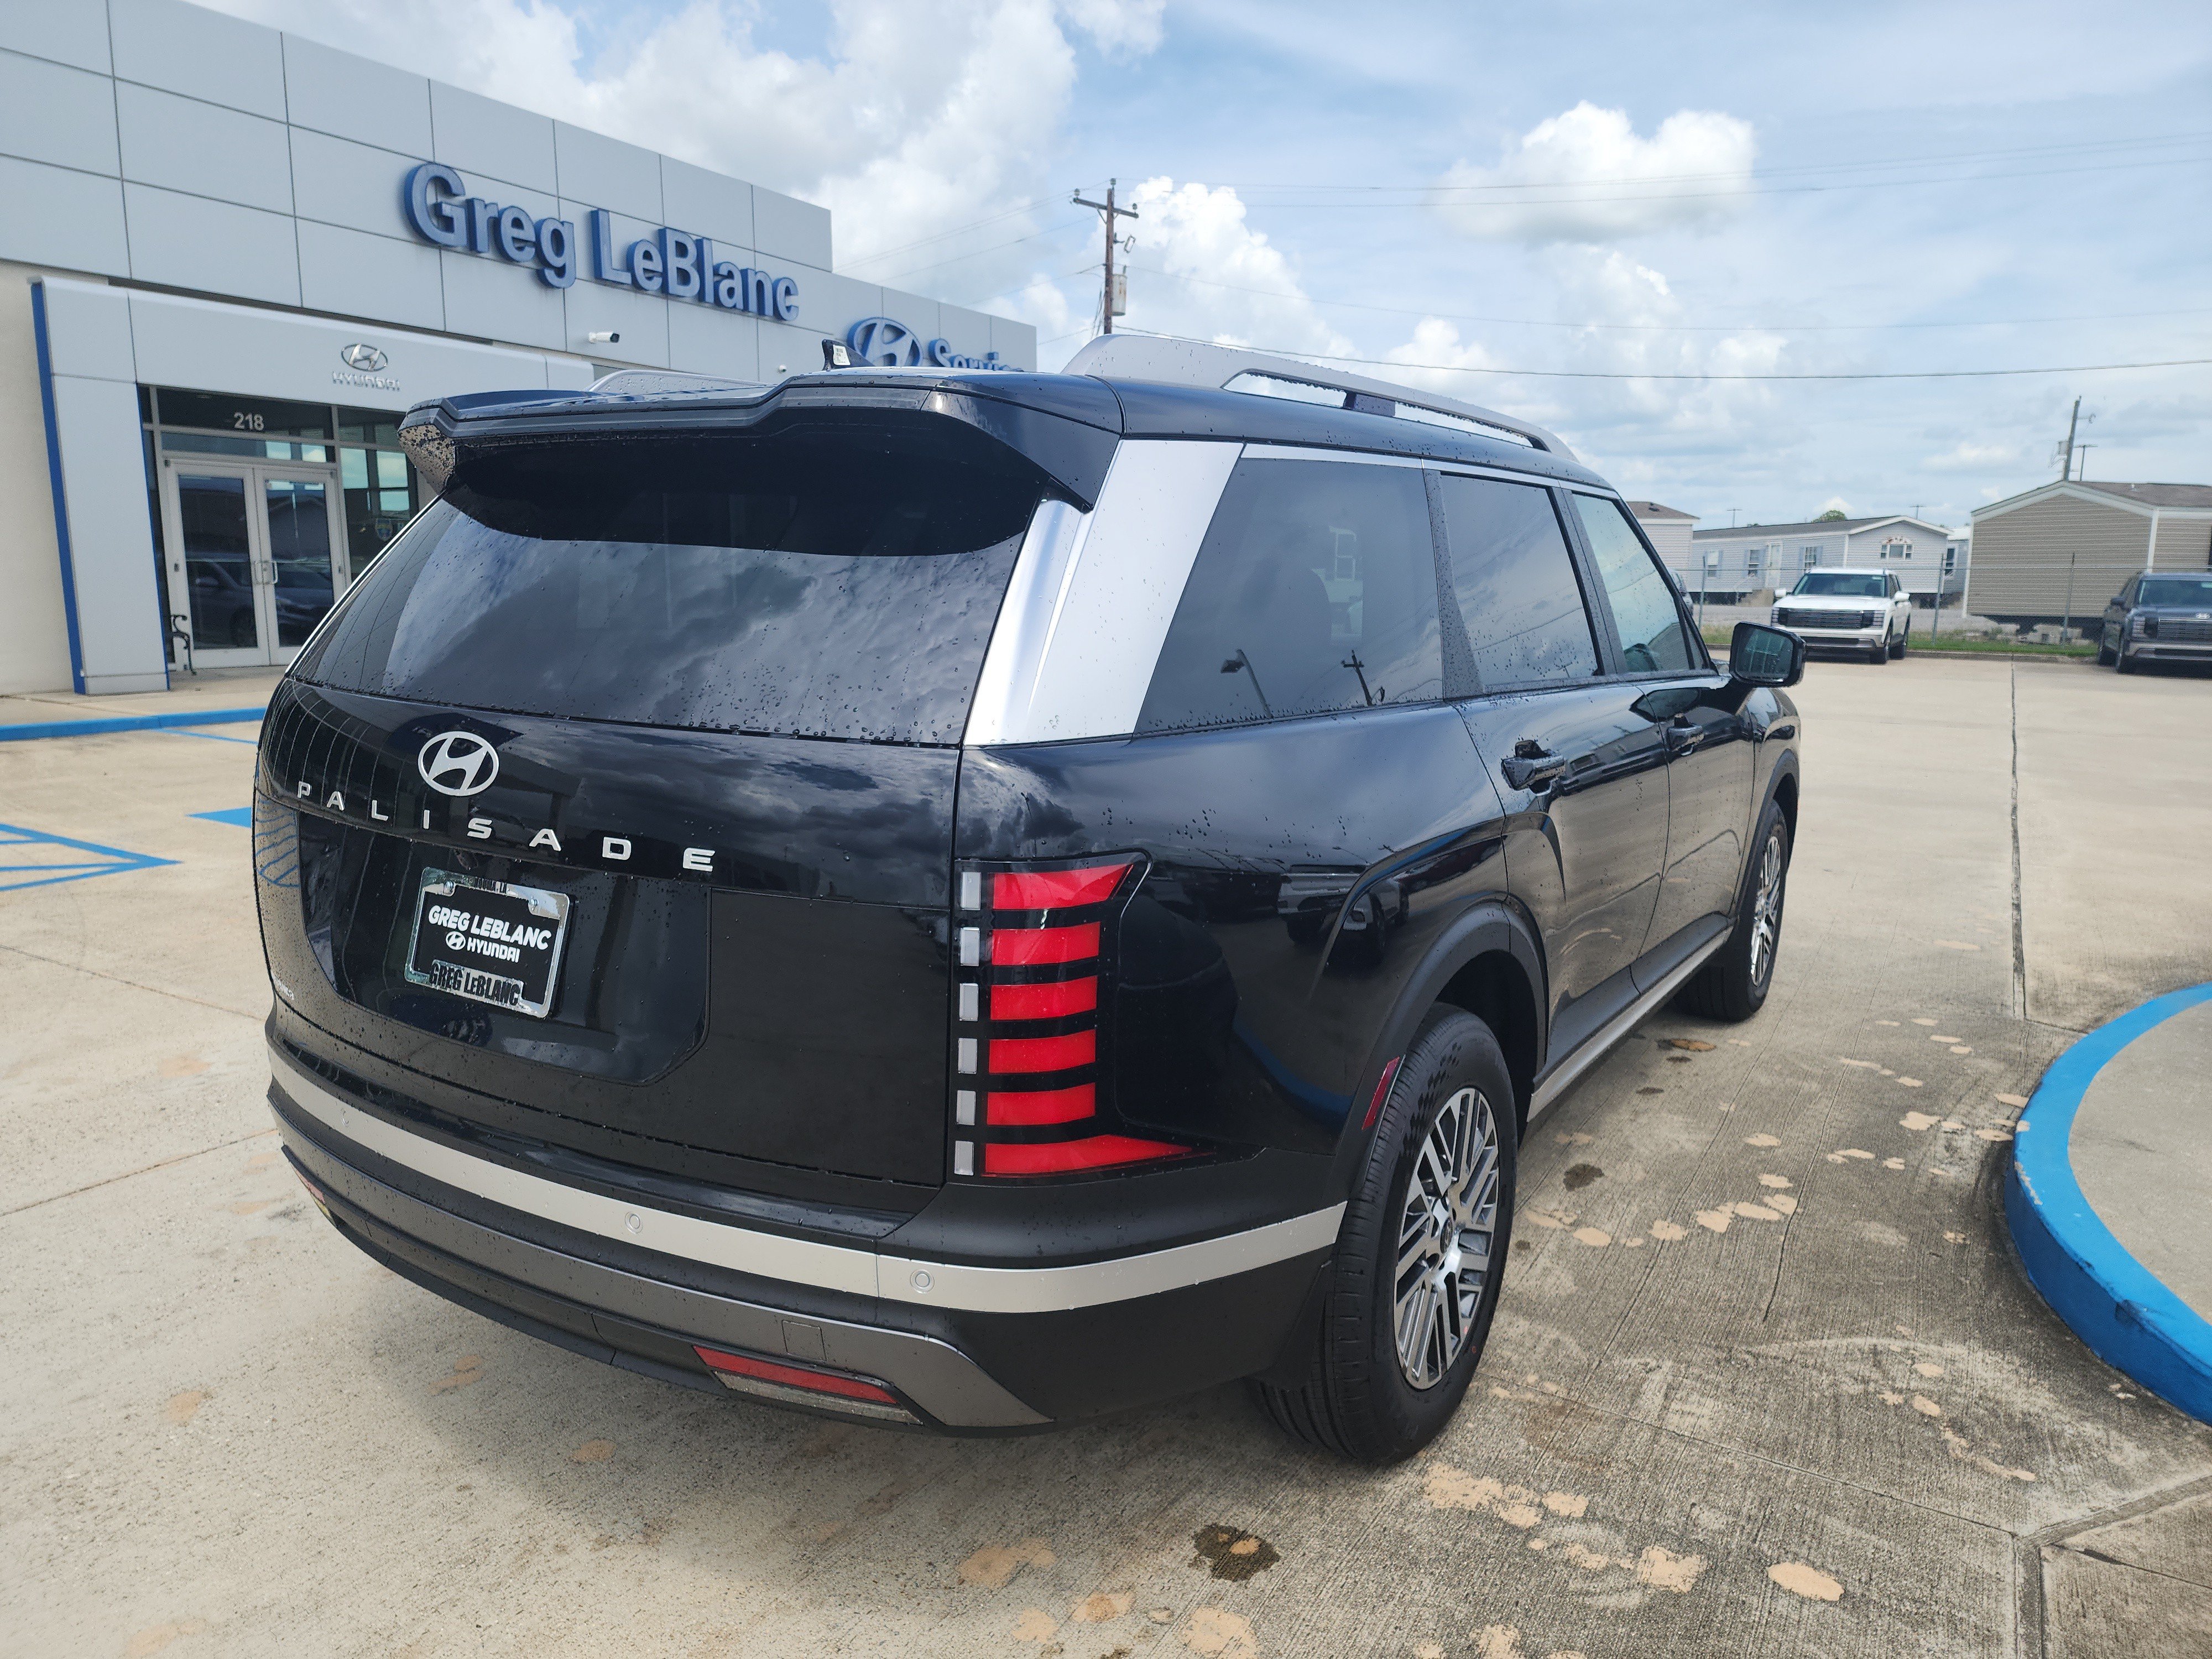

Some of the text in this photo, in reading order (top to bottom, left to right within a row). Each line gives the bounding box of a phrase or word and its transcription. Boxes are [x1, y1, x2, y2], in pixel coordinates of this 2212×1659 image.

[404, 162, 799, 322] Greg LeBlanc
[332, 371, 400, 391] HYUNDAI
[233, 411, 264, 431] 218
[297, 780, 716, 872] PALISADE
[428, 905, 552, 950] GREG LEBLANC
[467, 937, 520, 963] HYUNDAI
[429, 962, 463, 992] GREG
